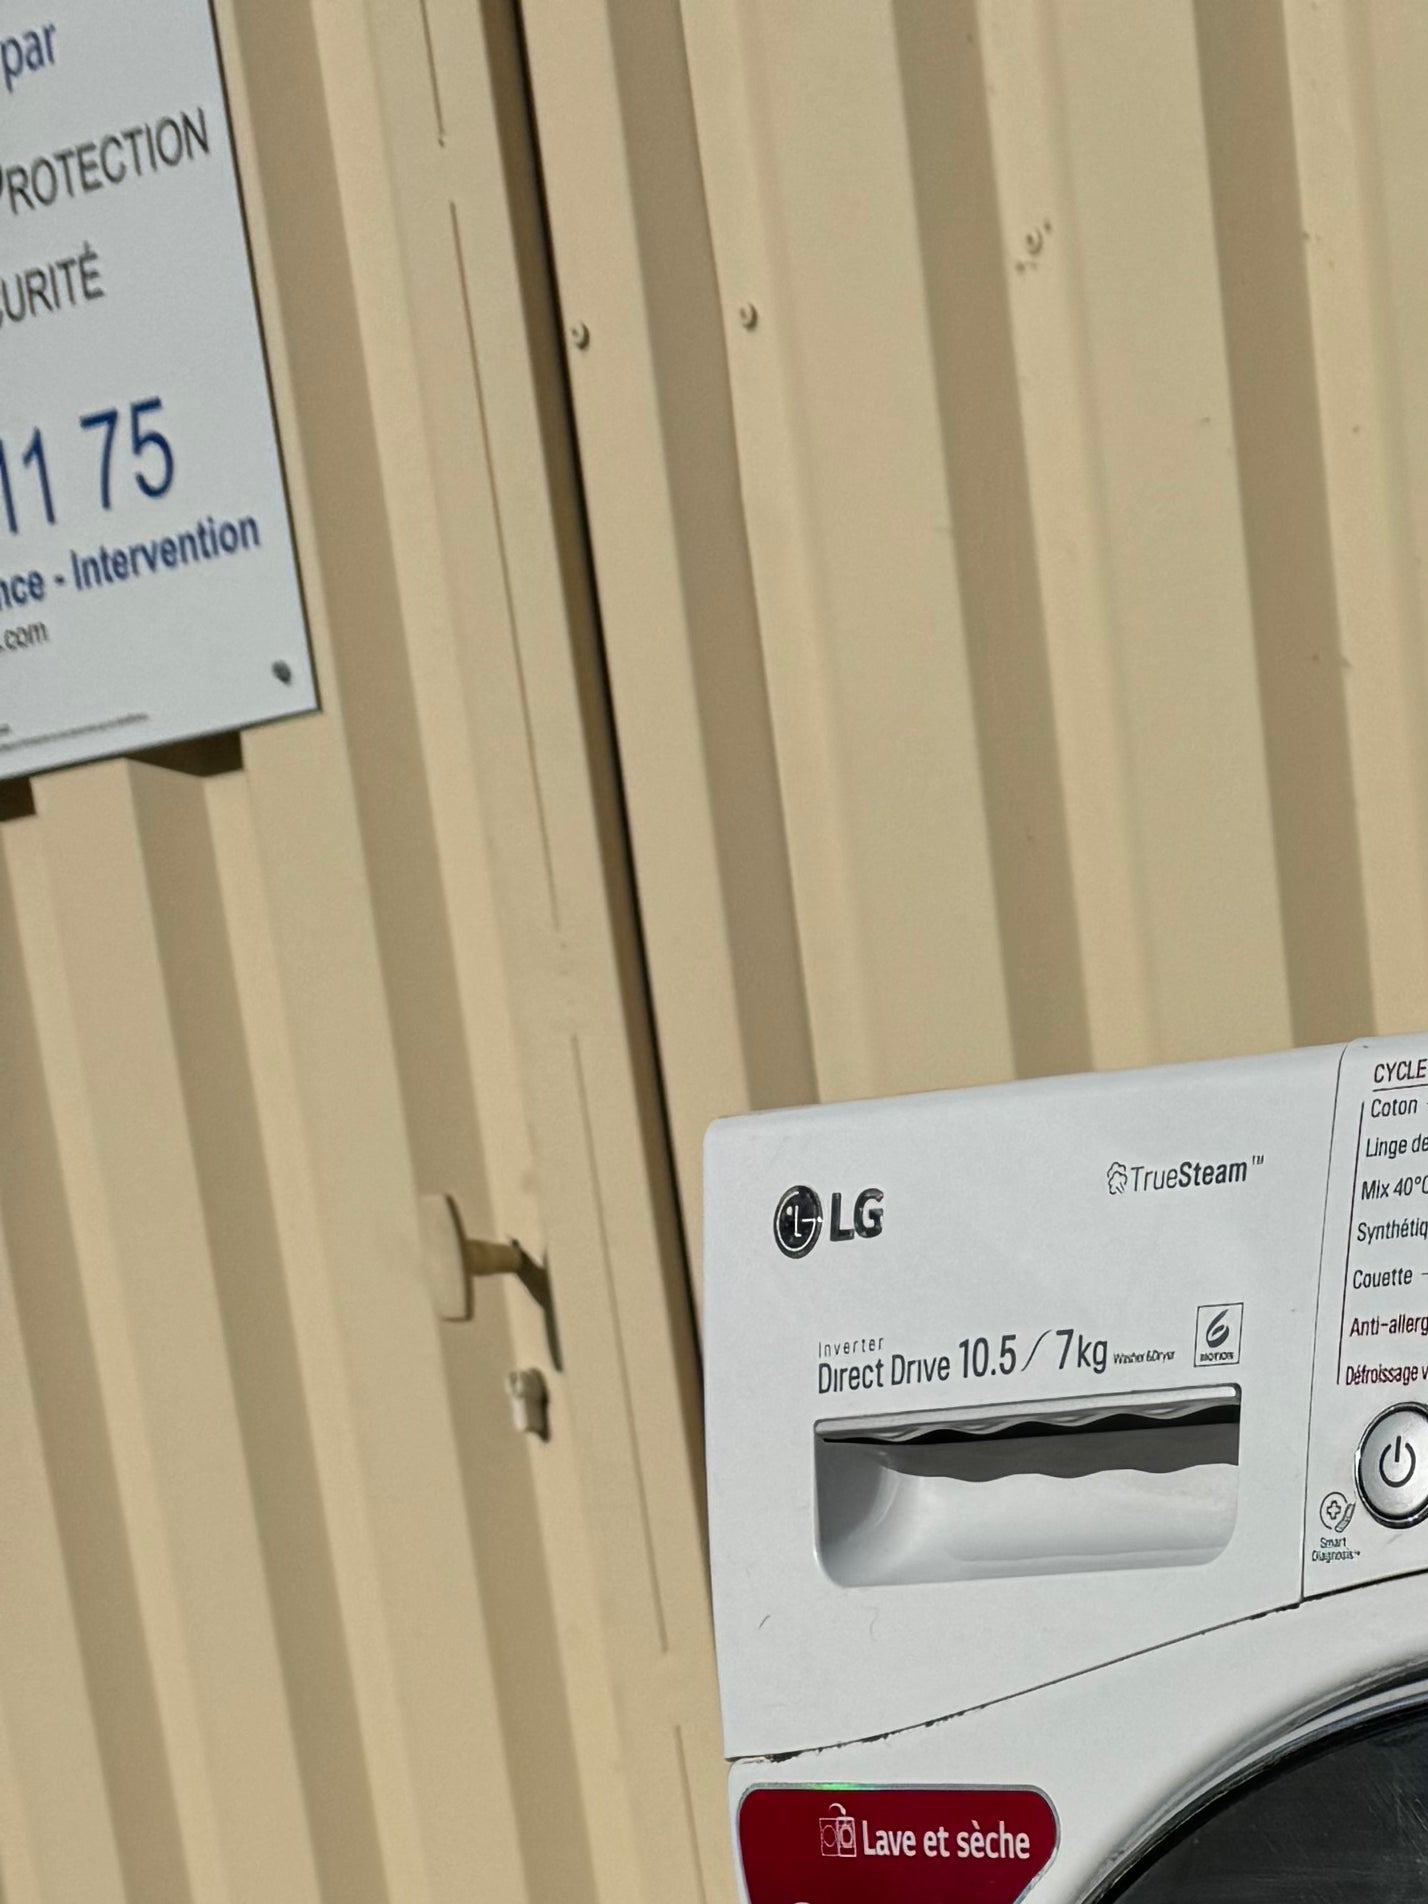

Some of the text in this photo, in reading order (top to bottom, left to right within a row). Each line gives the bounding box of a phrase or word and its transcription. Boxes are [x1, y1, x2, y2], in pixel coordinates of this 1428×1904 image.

[0, 23, 55, 93] par
[0, 106, 210, 215] ROTECTION
[0, 240, 104, 325] URITÉ
[80, 397, 174, 510] 75
[71, 514, 261, 592] Intervention
[1374, 1058, 1427, 1083] CYCLE
[1371, 1099, 1418, 1118] Coton
[1366, 1137, 1407, 1159] Linge
[1361, 1180, 1390, 1200] Mix
[829, 1188, 884, 1241] LG
[1353, 1268, 1413, 1289] Couette
[819, 1336, 884, 1358] Inverter
[819, 1362, 884, 1393] Direct
[891, 1355, 950, 1385] Drive
[959, 1335, 1017, 1378] 10.5
[1056, 1329, 1108, 1374] 7kg
[1346, 1363, 1418, 1386] Défroissage
[1320, 1537, 1346, 1549] Smart
[862, 1820, 1031, 1859] Lave et sèche
